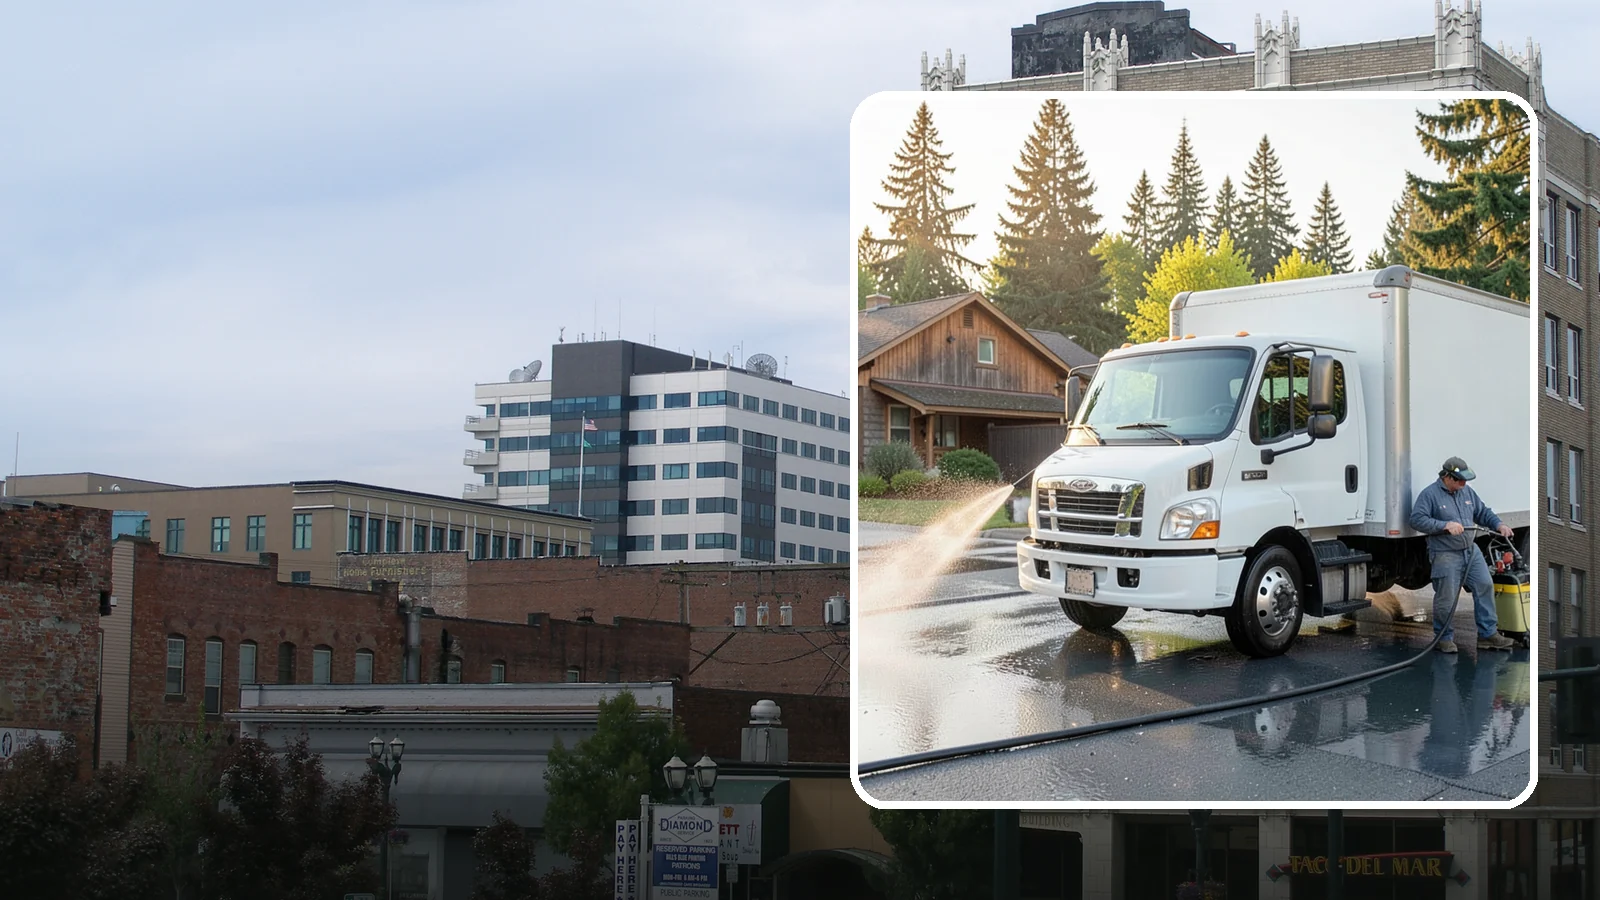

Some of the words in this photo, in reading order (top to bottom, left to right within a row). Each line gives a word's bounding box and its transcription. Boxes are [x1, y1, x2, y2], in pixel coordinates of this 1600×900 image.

[660, 818, 713, 833] DIAMOND
[1022, 815, 1069, 828] BUILDING
[617, 824, 625, 852] PAY
[628, 824, 637, 852] PAY
[655, 845, 688, 853] RESERVED
[689, 846, 716, 854] PARKING
[721, 851, 739, 862] Soup
[671, 862, 701, 870] PATRONS
[1289, 855, 1329, 874] TAC
[1345, 856, 1384, 876] DEL
[1392, 857, 1442, 877] MAR
[616, 856, 625, 894] HERE
[627, 855, 636, 894] HERE
[660, 888, 682, 897] PUBLIC
[683, 889, 710, 898] PARKING
